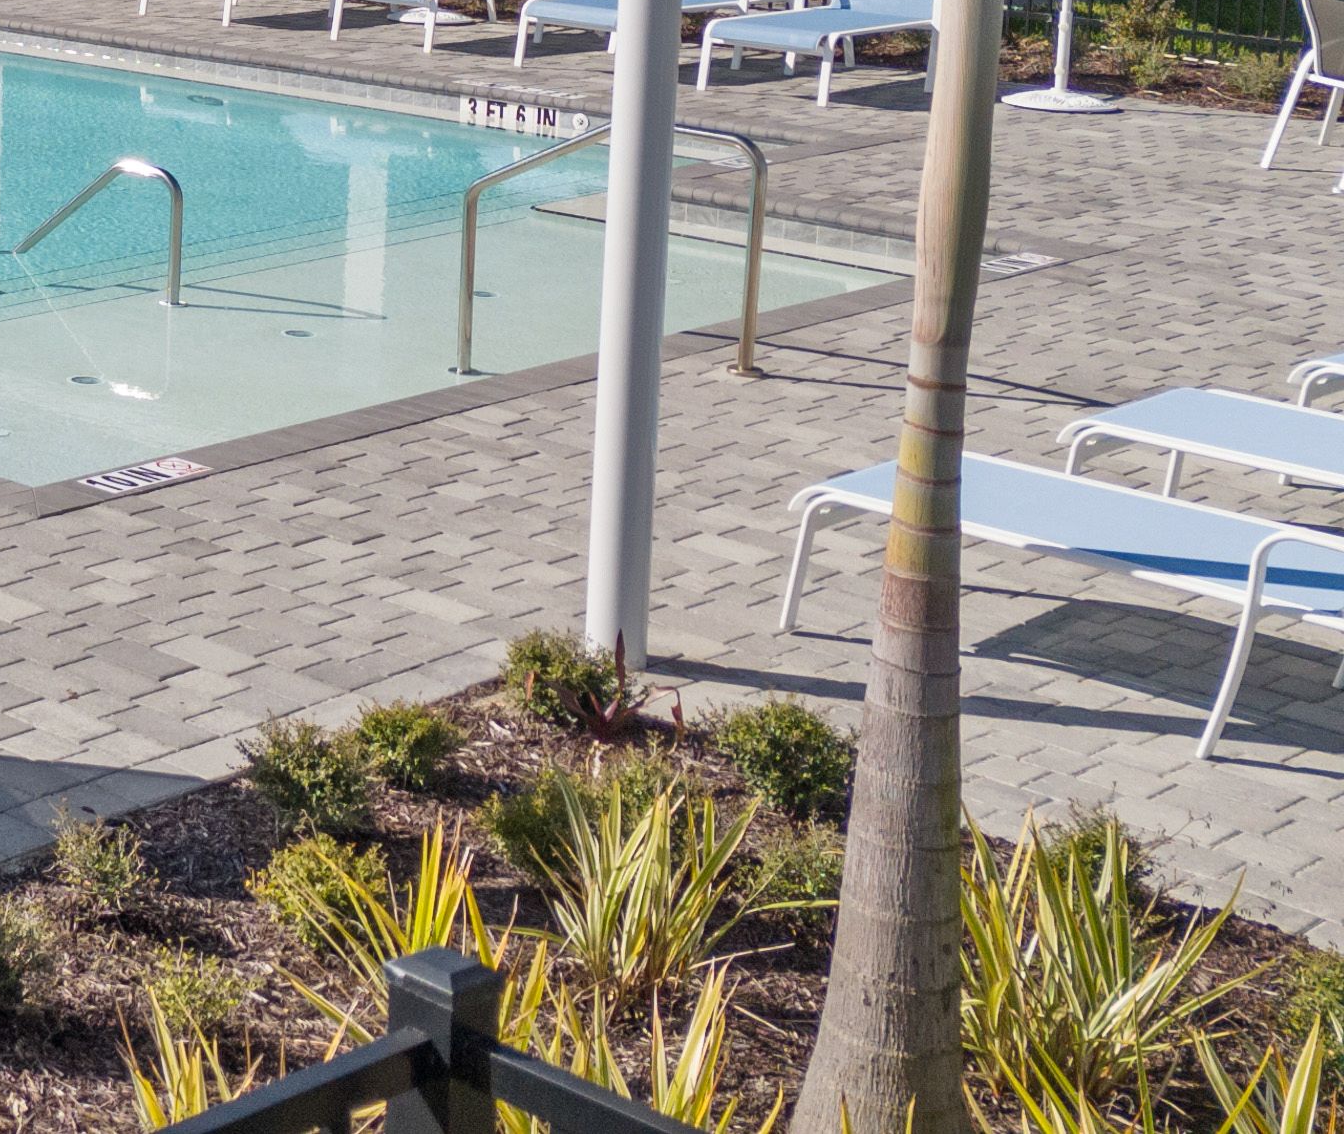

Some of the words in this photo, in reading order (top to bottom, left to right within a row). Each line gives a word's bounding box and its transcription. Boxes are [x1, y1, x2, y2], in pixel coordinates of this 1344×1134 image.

[468, 97, 477, 117] 3
[486, 100, 508, 121] FT
[516, 104, 526, 125] 6
[536, 107, 557, 128] IN
[86, 475, 139, 491] 10
[117, 466, 173, 483] IN
